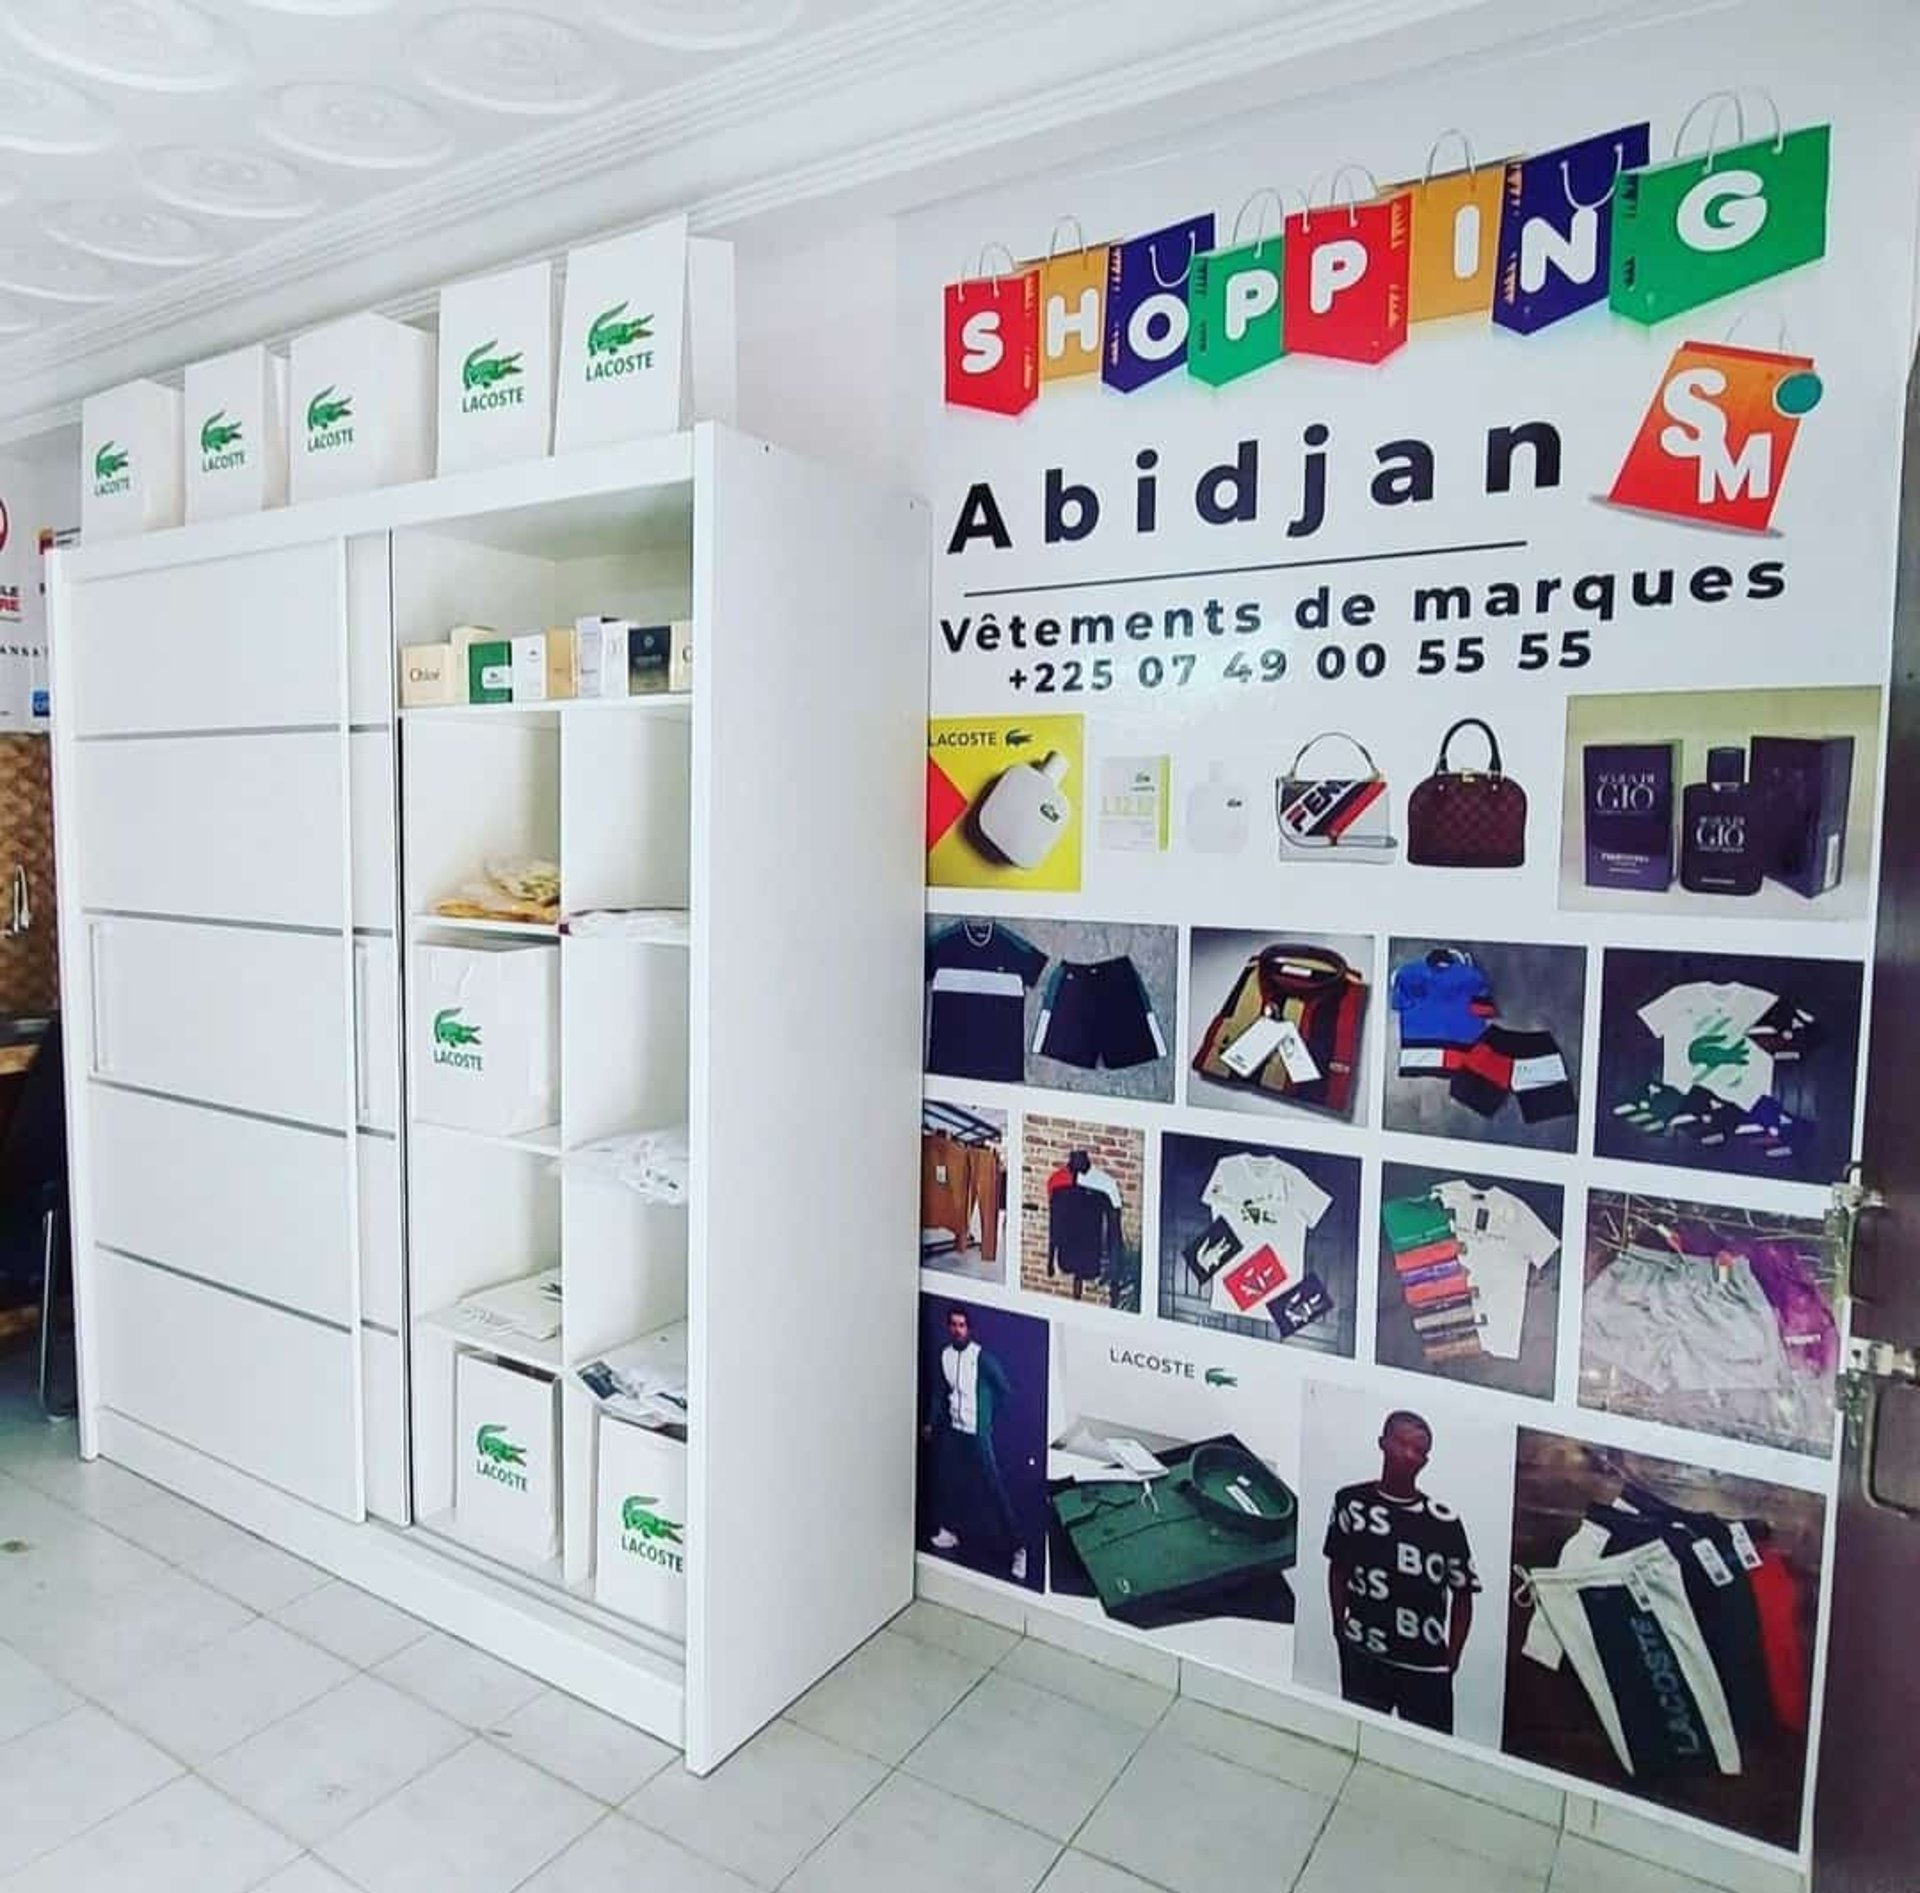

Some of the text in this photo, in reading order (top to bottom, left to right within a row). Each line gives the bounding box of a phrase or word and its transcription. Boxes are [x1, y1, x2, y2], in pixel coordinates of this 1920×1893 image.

[961, 169, 1767, 374] SHOPPING
[585, 350, 655, 382] LACOSTE
[462, 386, 525, 413] LACOSTE
[307, 427, 355, 453] LACOSTE
[201, 452, 245, 472] LACOSTE
[947, 420, 1561, 555] Abidjan
[940, 560, 1785, 654] Vêtements de marques
[1009, 630, 1592, 694] +225 07 49 00 55 55
[433, 1049, 485, 1072] LACOSTE
[1109, 1344, 1196, 1379] LACOSTE
[475, 1459, 528, 1493] LACOSTE
[621, 1534, 684, 1573] LACOSTE
